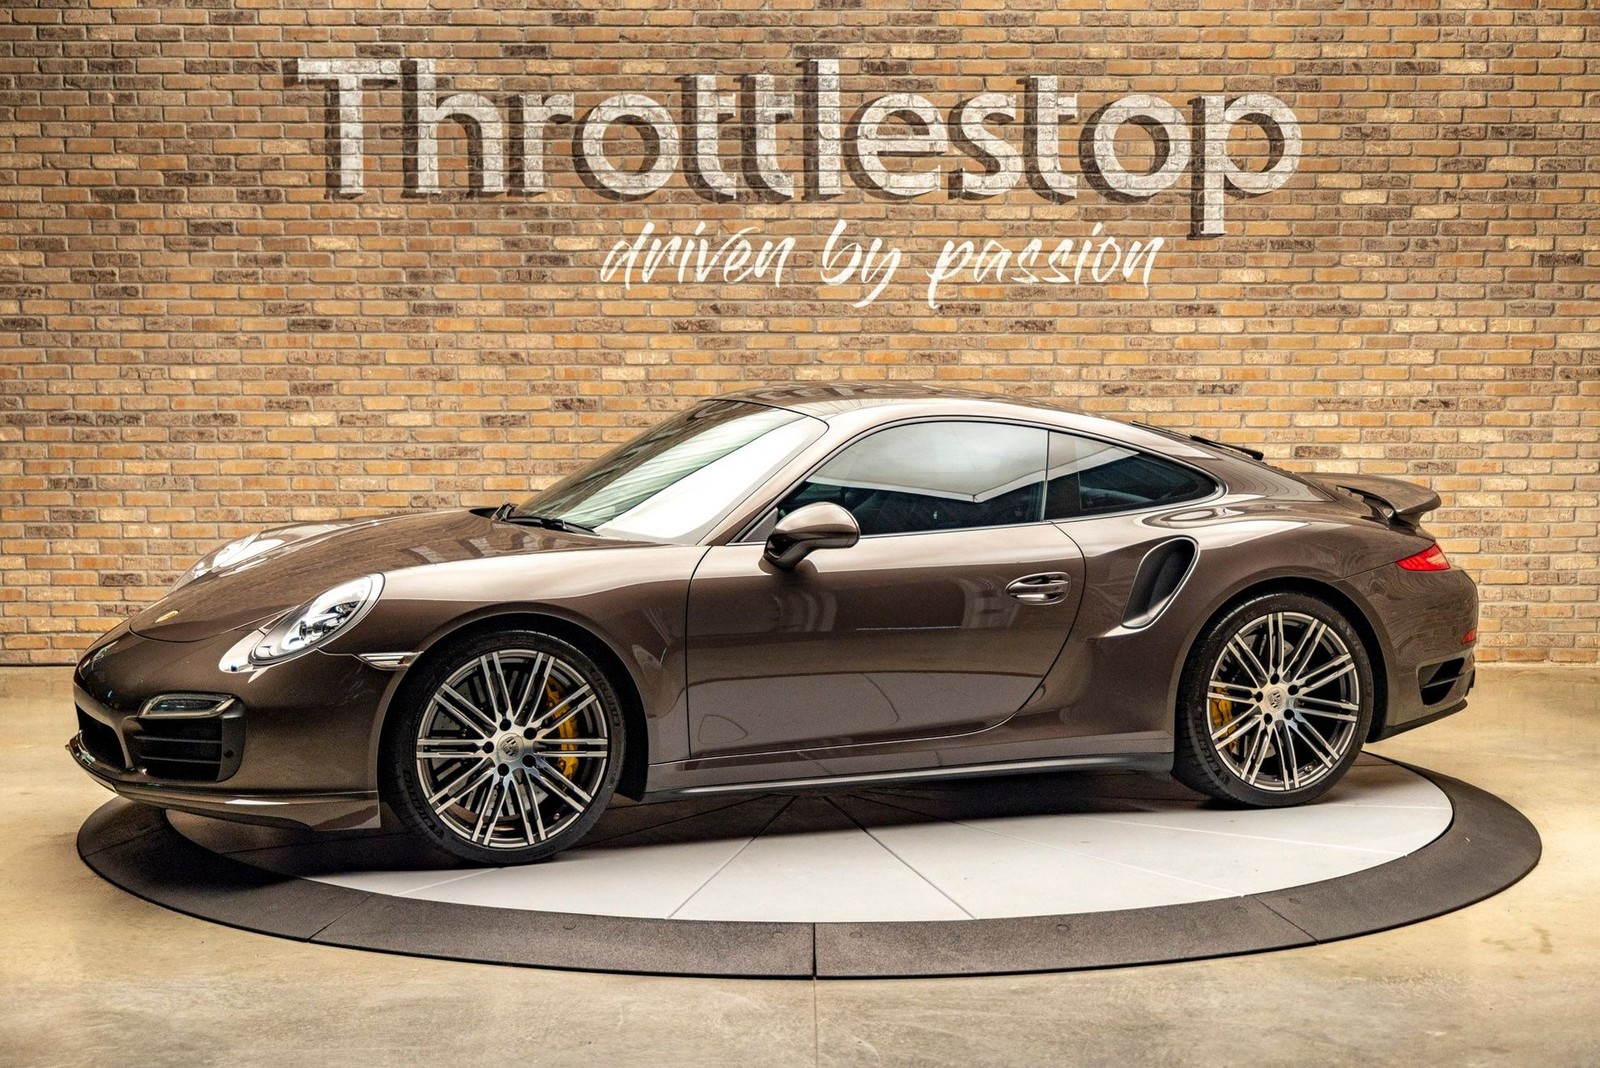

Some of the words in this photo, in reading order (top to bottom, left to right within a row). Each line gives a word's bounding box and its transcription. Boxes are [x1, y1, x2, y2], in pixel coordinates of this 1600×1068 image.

[290, 58, 1302, 238] Throttlestop
[600, 221, 796, 289] driven
[820, 219, 901, 308] by
[926, 222, 1165, 309] passion
